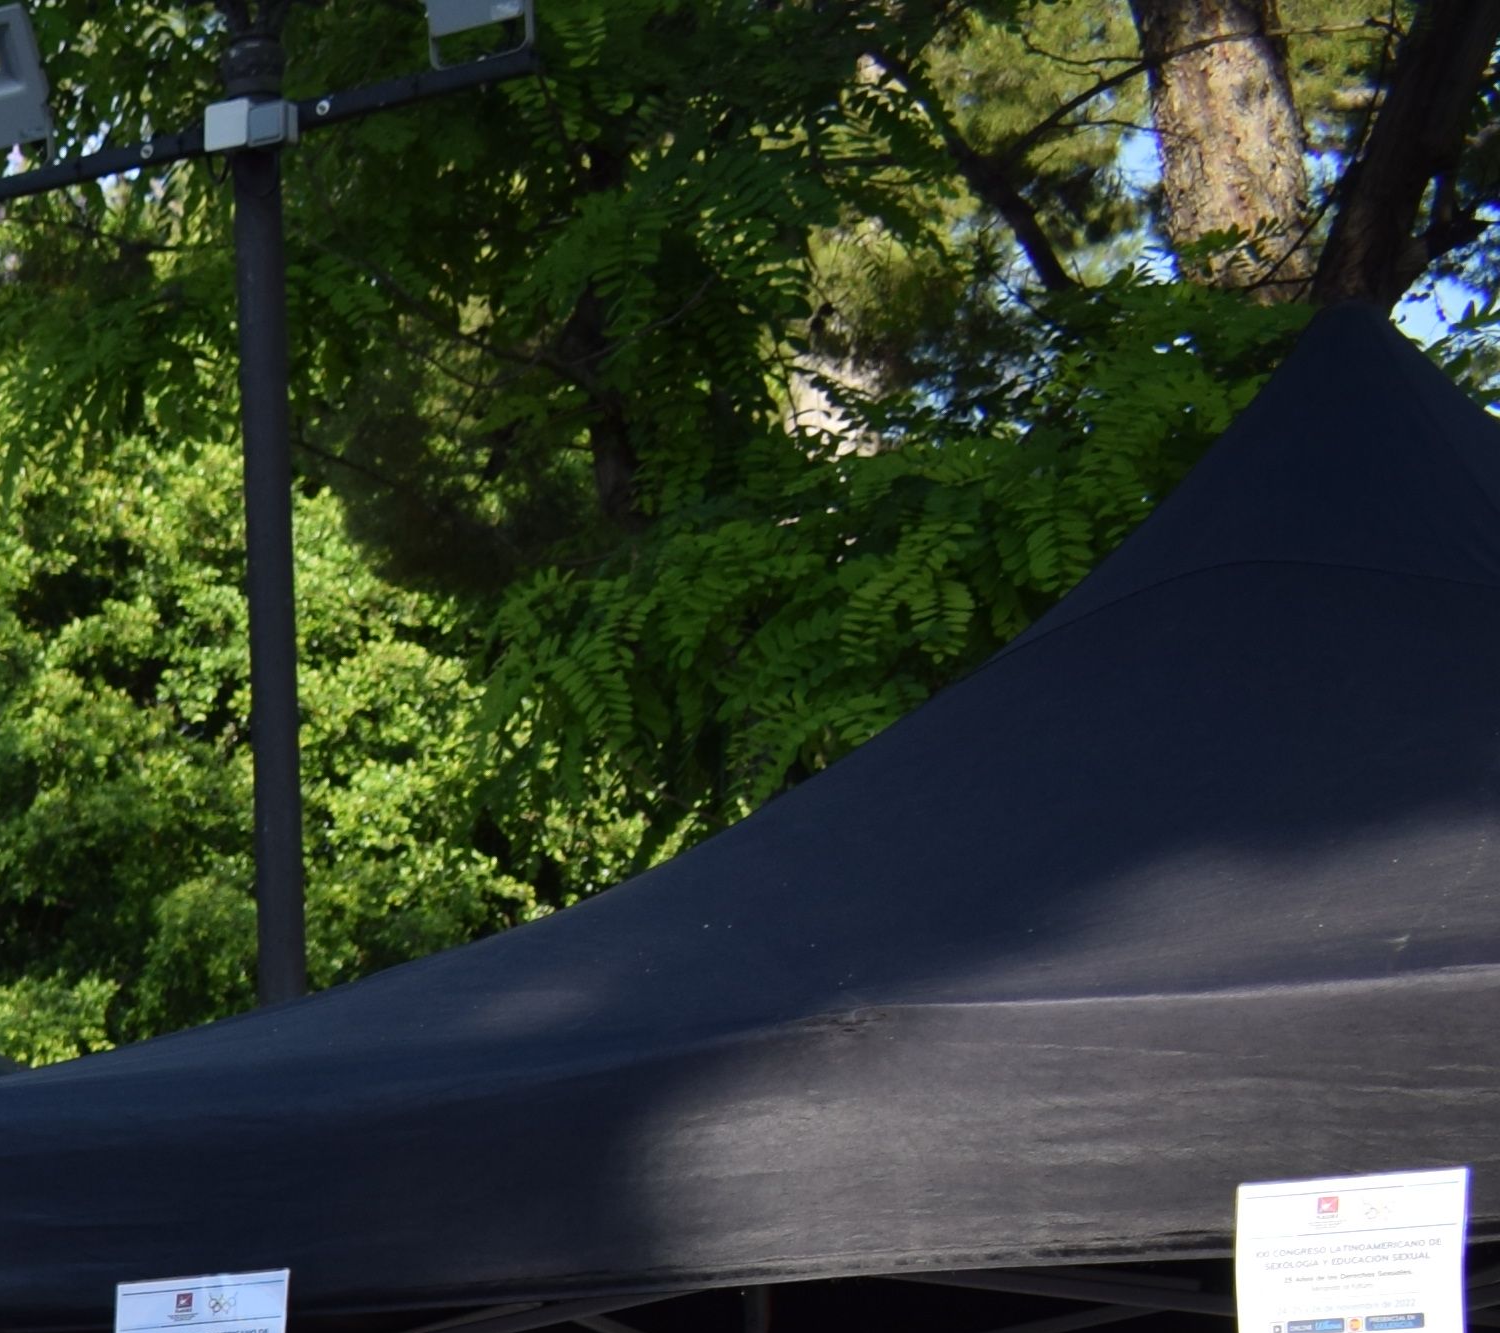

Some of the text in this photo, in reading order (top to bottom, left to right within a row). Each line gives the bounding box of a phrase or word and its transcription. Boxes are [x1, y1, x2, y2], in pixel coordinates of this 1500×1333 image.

[1273, 1246, 1327, 1258] CONGRESO
[1330, 1239, 1426, 1254] LATINOAMERICANO
[1428, 1238, 1442, 1247] DE
[1392, 1251, 1431, 1262] SEXUAL
